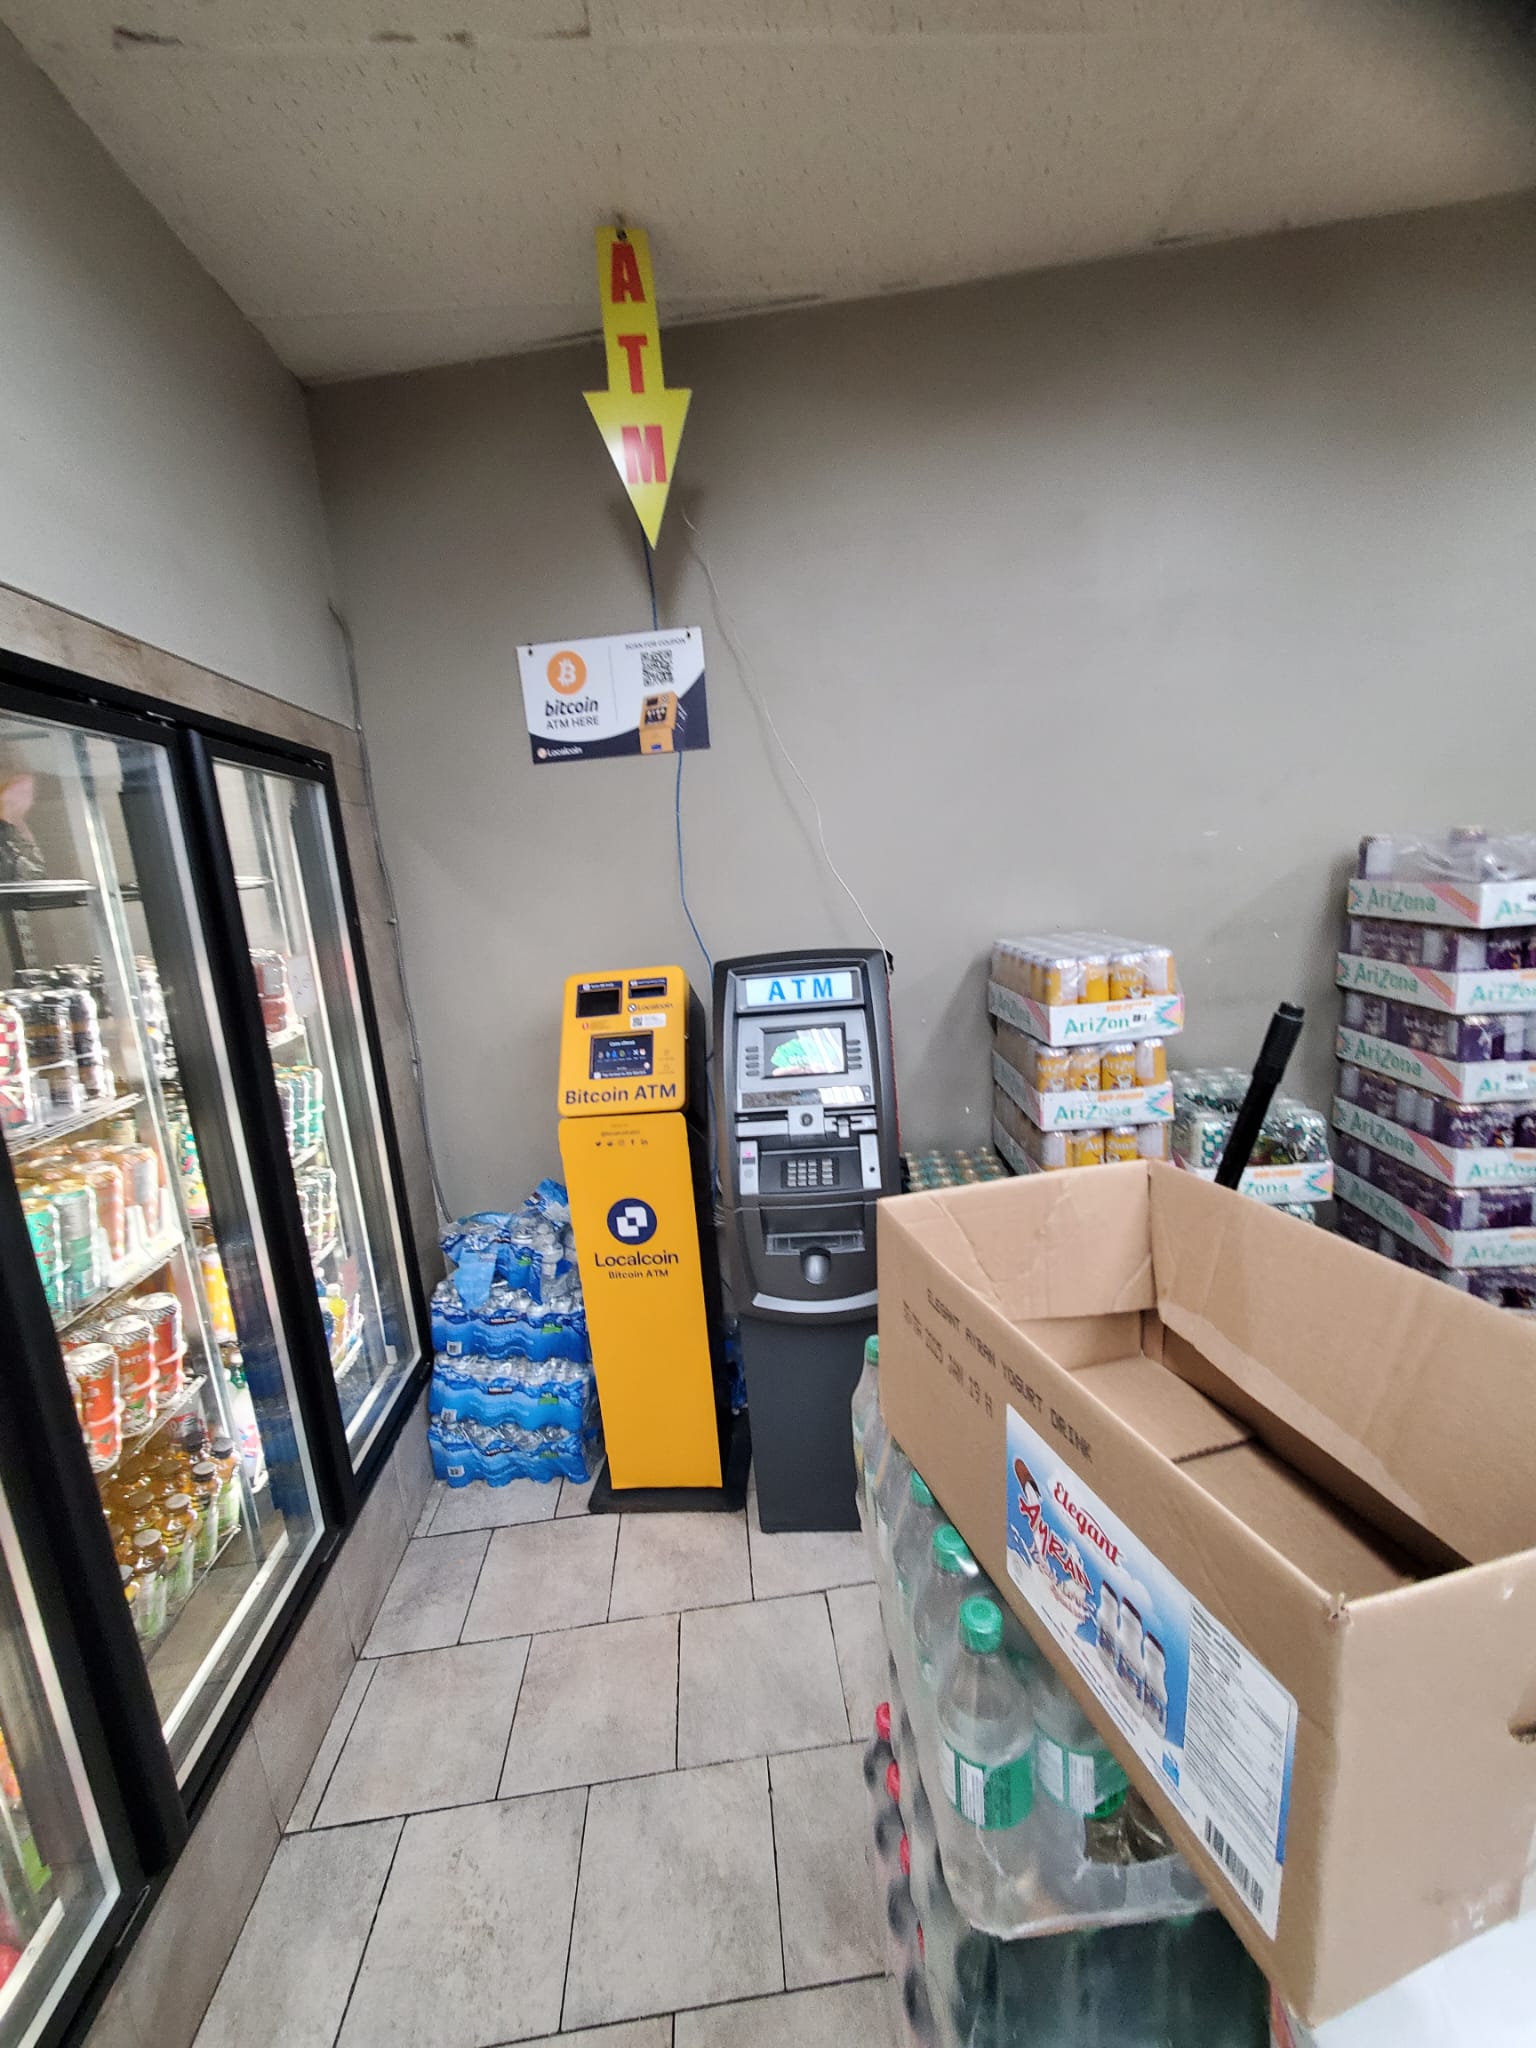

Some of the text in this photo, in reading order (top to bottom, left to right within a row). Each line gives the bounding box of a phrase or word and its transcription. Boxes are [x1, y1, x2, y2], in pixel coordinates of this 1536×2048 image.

[610, 241, 668, 484] ATM
[545, 696, 599, 717] bitcoin
[546, 715, 600, 730] ATM HERE
[1366, 887, 1437, 913] AriZona
[1354, 962, 1419, 993] AriZona
[768, 977, 834, 1002] ATM
[1064, 1015, 1130, 1038] AriZon
[565, 1083, 677, 1105] Bitcoin ATM
[1245, 1181, 1289, 1196] Zona
[594, 1249, 679, 1268] Localcoin
[608, 1269, 669, 1280] Bitcoin ATM
[1049, 1407, 1093, 1463] DRINK
[1052, 1481, 1122, 1567] Elegant
